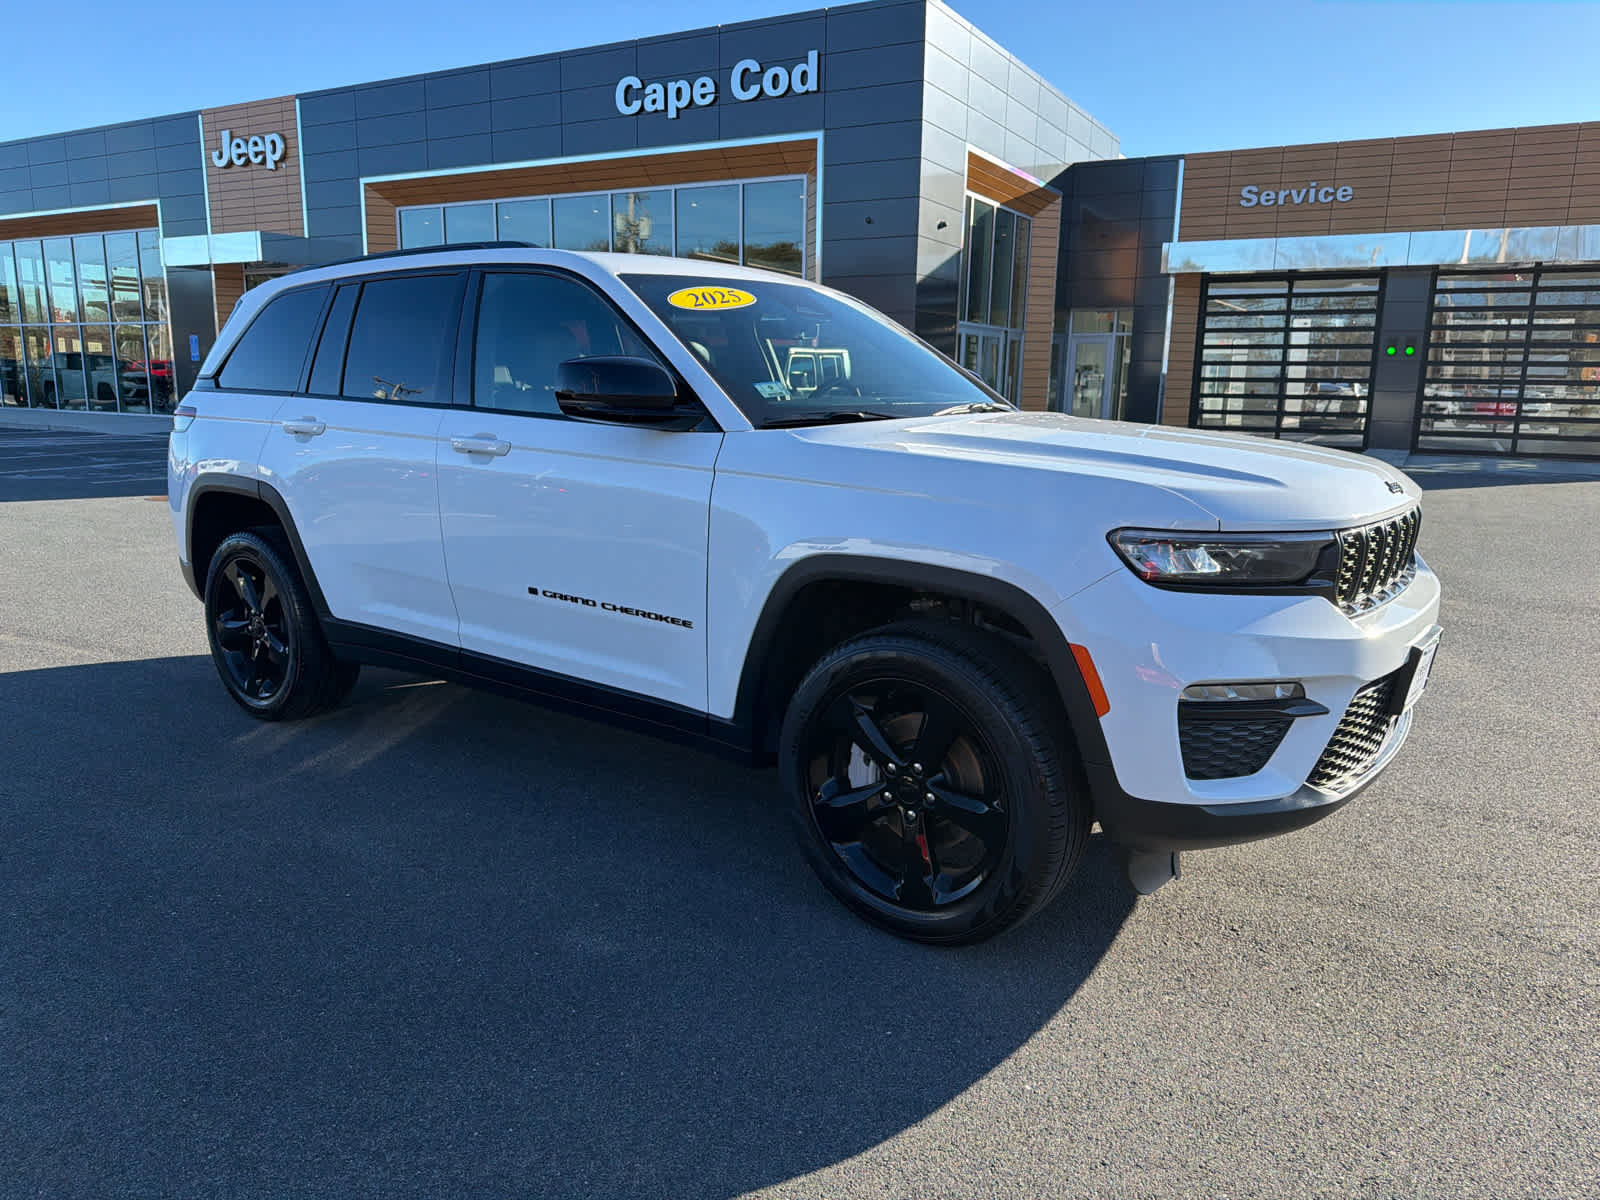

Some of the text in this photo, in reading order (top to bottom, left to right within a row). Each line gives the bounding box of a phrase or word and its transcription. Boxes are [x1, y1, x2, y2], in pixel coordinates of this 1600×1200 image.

[615, 50, 819, 119] Cape Cod
[211, 129, 286, 170] Jeep
[1240, 181, 1353, 207] Service
[687, 290, 742, 307] 2025
[542, 589, 694, 629] GRAND CHEROKEE
